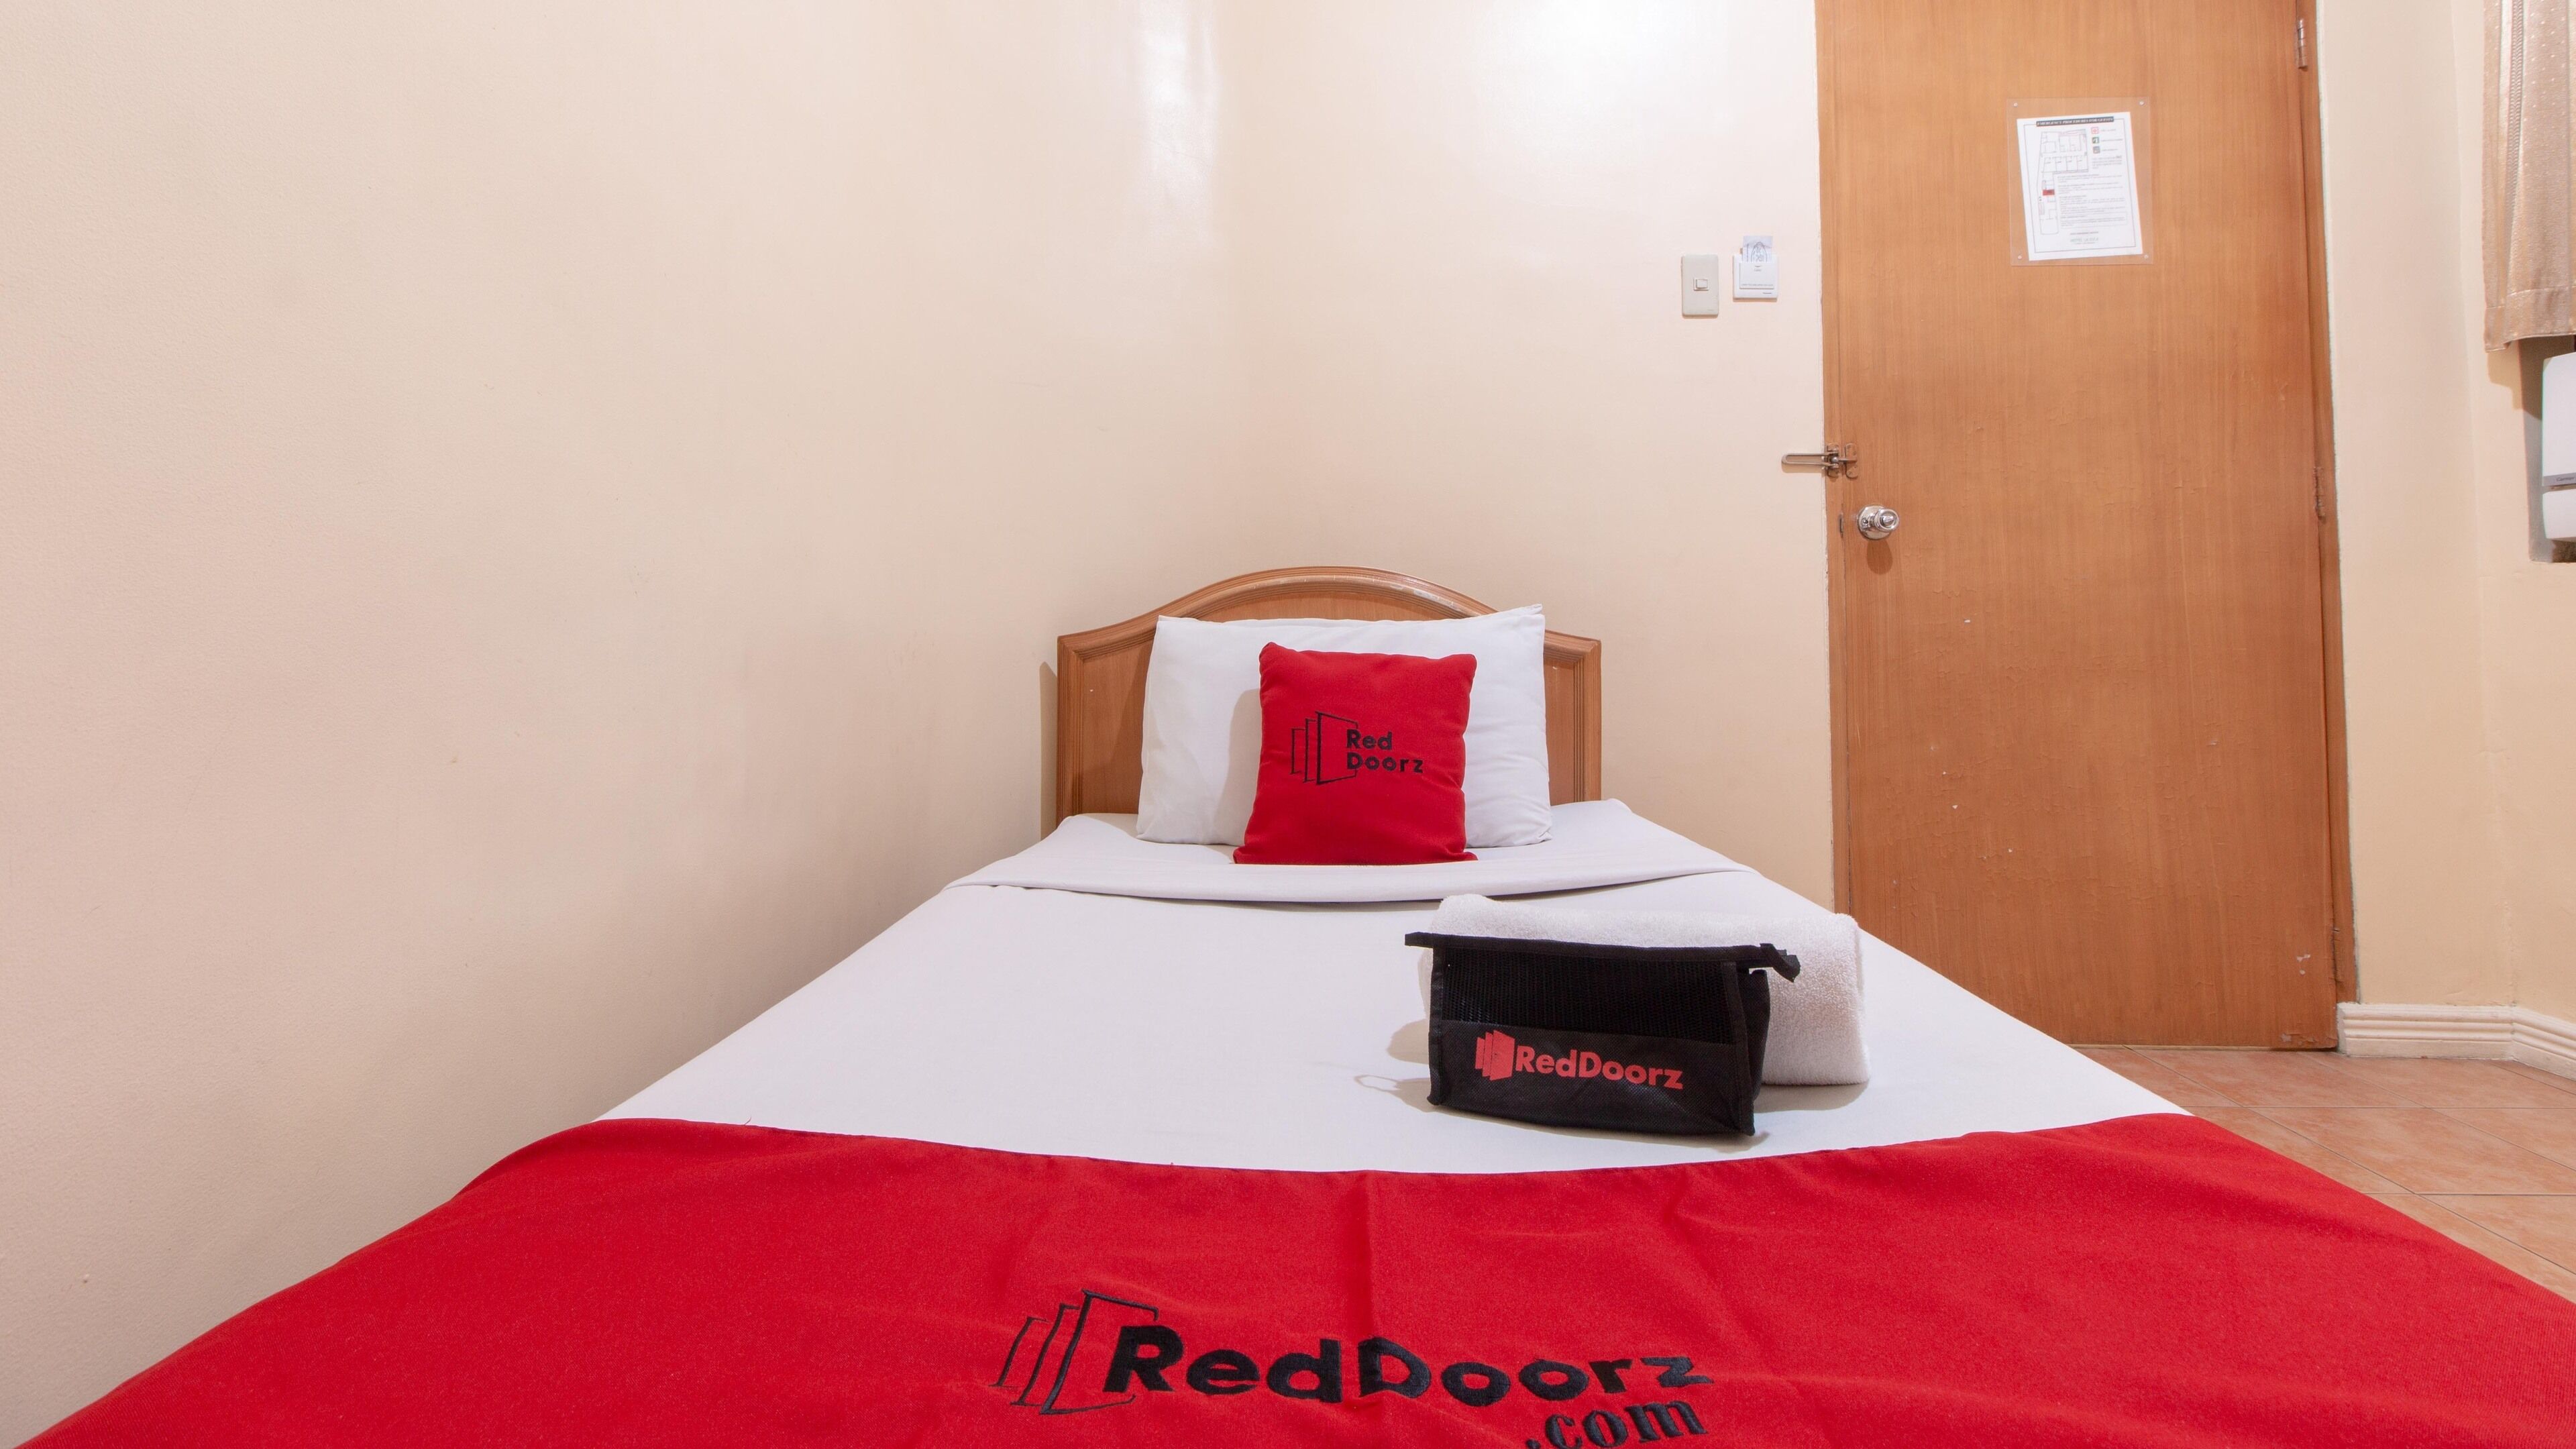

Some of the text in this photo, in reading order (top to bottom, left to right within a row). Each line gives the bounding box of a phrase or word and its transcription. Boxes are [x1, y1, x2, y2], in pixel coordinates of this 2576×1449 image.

[1346, 729, 1393, 750] Red
[1346, 752, 1424, 773] Doorz
[1515, 1045, 1683, 1089] RedDoorz
[1102, 1324, 1713, 1407] RedDoorz
[1525, 1400, 1709, 1449] .com
